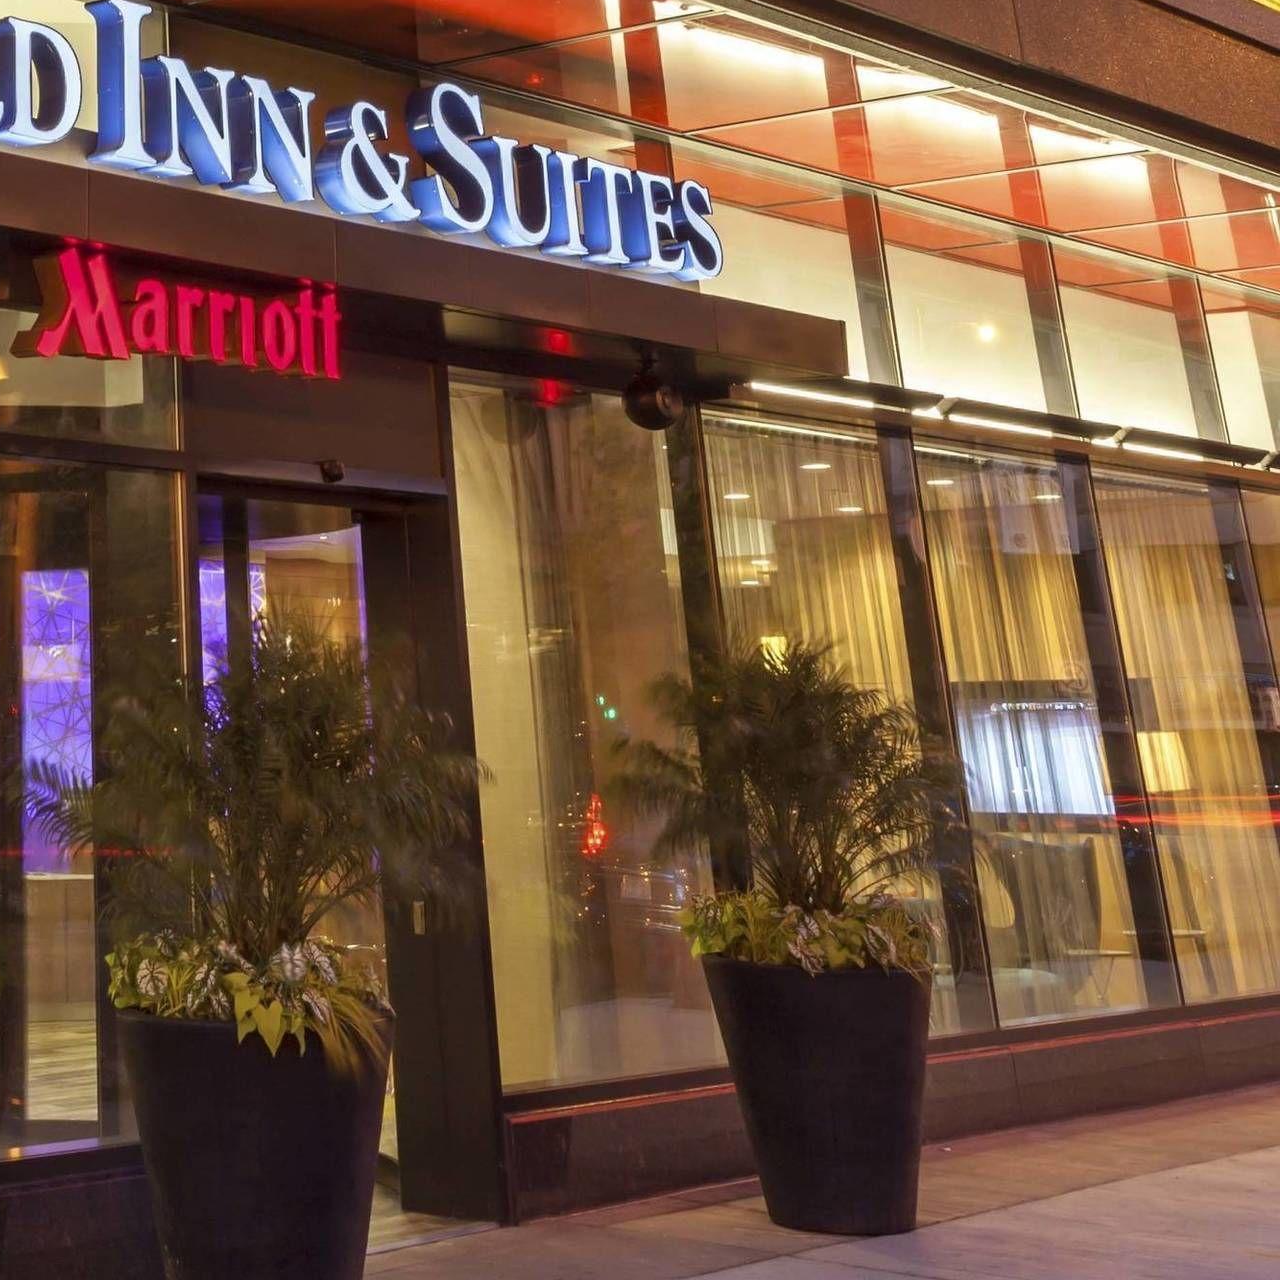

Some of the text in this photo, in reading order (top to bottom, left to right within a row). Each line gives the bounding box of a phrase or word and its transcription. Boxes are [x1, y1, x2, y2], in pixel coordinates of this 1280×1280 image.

[315, 101, 421, 223] &
[407, 81, 725, 281] SUITES
[35, 238, 343, 381] Marriott
